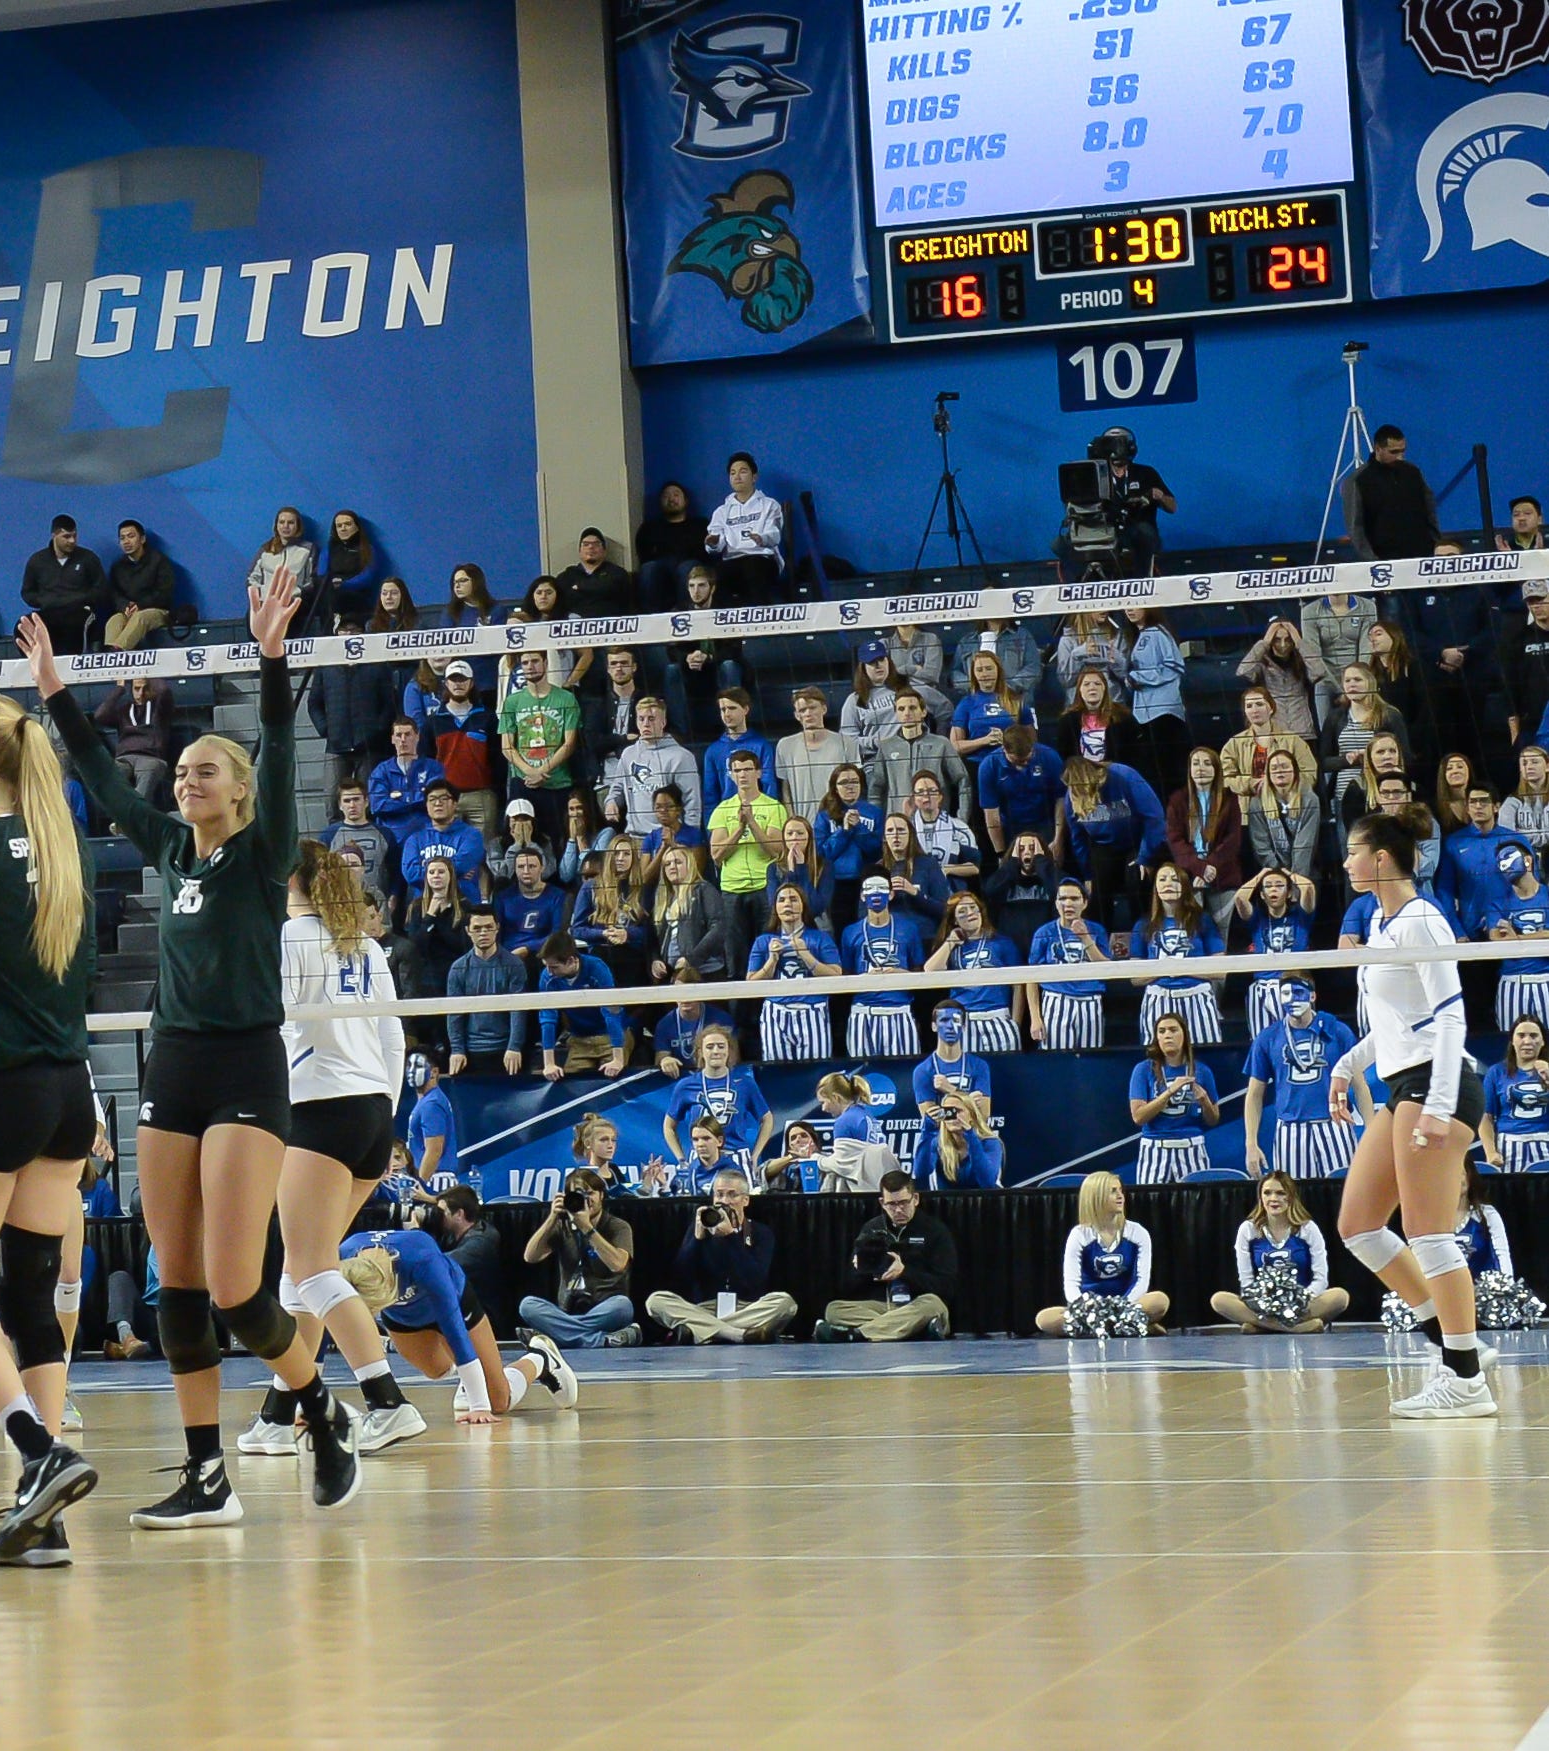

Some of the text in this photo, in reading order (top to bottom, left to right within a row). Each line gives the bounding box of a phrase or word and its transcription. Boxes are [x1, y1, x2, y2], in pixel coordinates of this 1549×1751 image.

[868, 2, 1023, 42] HITTING %
[1241, 13, 1292, 47] 67
[1093, 28, 1133, 60] 51
[887, 49, 972, 81] KILLS
[1242, 59, 1295, 93] 63
[1087, 73, 1139, 107] 56
[885, 94, 961, 125] DIGS
[1242, 103, 1304, 139] 7.0
[1082, 117, 1148, 152] 8.0
[884, 133, 1007, 169] BLOCKS
[1260, 148, 1289, 179] 4
[1103, 160, 1130, 192] 3
[885, 181, 967, 213] ACES
[1209, 203, 1317, 234] MICH.ST.
[900, 229, 1028, 263] CREIGHTON
[1093, 217, 1181, 264] 1:30
[1268, 246, 1326, 290] 24
[940, 276, 983, 318] 16
[1060, 288, 1123, 311] PERIOD
[1133, 278, 1153, 305] 4
[1068, 338, 1184, 402] 107
[1236, 566, 1335, 588] CREIGHTON
[1418, 554, 1520, 576] CREIGHTON
[884, 593, 979, 614] CREIGHTON
[1058, 580, 1155, 601] CREIGHTON
[549, 618, 639, 639] CREIGHTON
[714, 604, 807, 625] CREIGHTON
[227, 639, 315, 659] CRETON
[386, 629, 475, 649] CREIGHTON
[71, 651, 156, 670] CREIGHTON
[337, 948, 372, 998] 21
[870, 1093, 896, 1105] CAA
[886, 1119, 923, 1131] DIVISI
